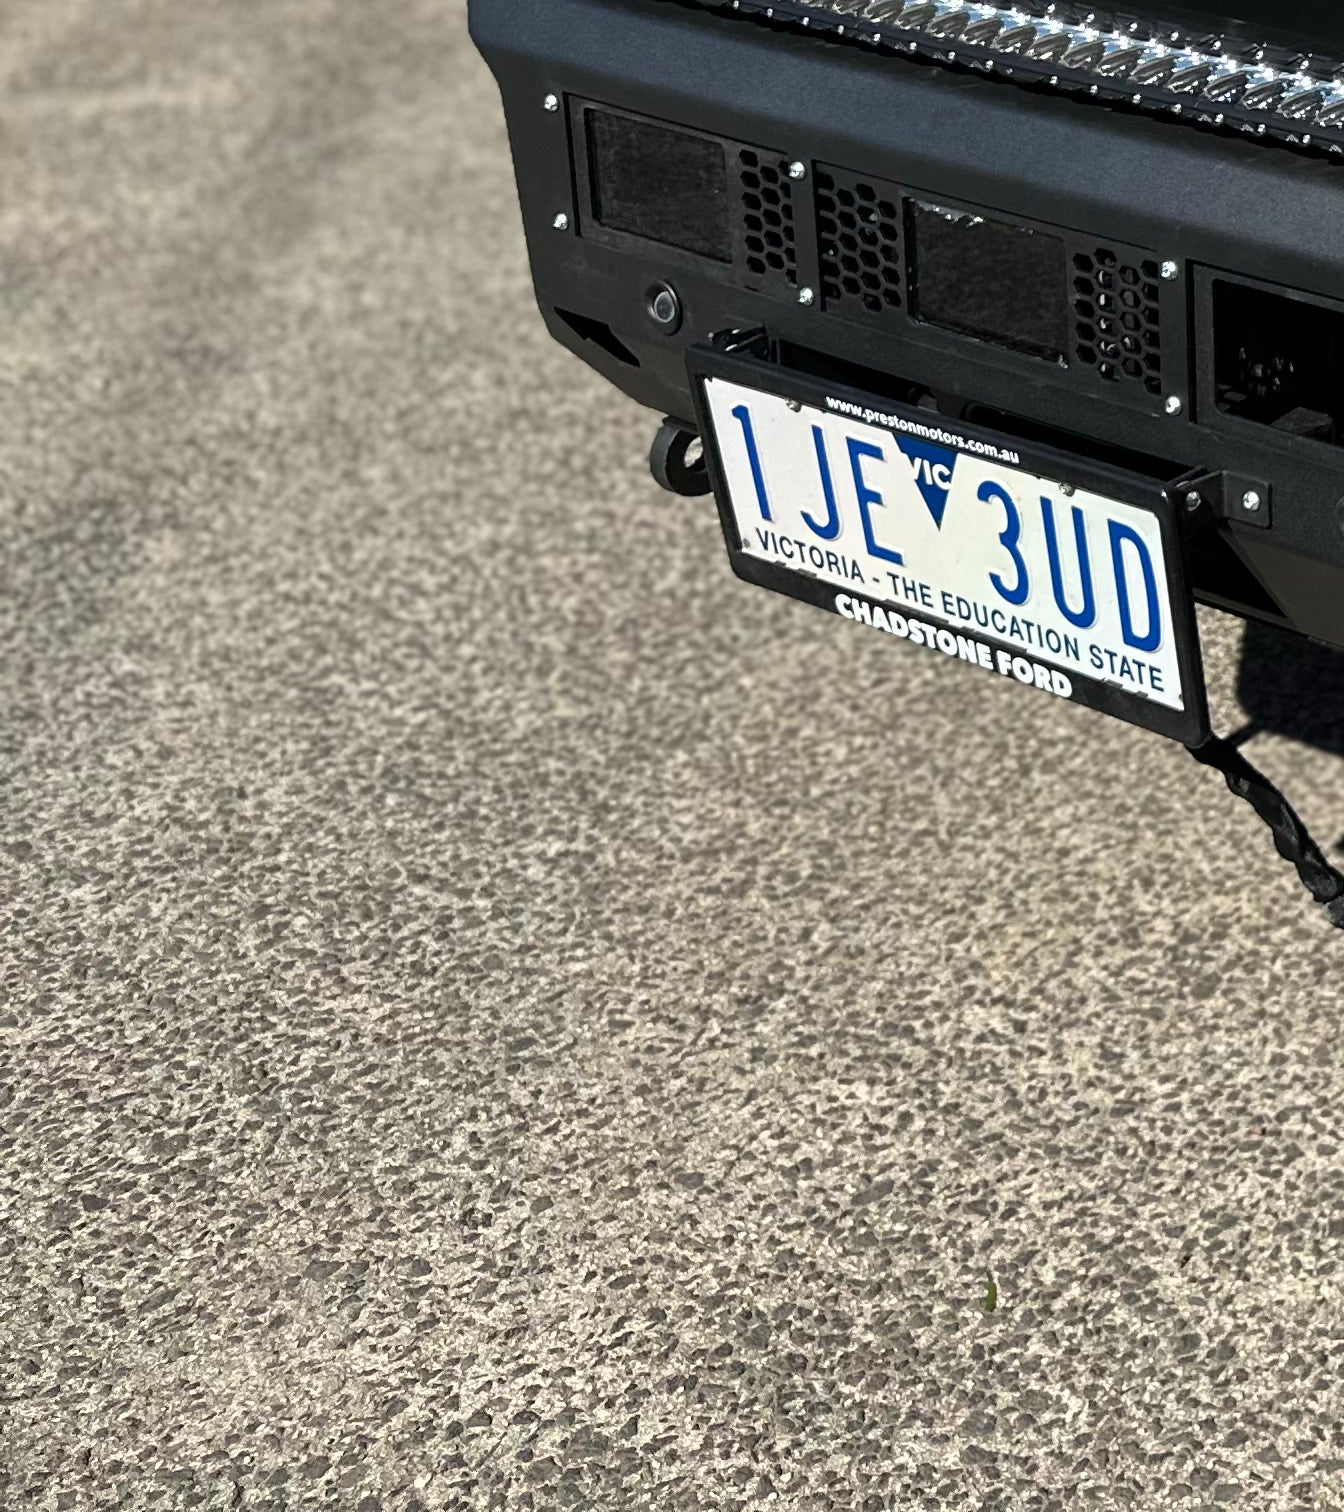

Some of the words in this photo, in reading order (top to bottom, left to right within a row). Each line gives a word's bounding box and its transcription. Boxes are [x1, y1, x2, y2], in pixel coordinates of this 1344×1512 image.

[826, 395, 1020, 465] www.prestonmotors.com.au
[911, 456, 952, 490] VIC
[755, 527, 866, 585] VICTORIA
[886, 571, 935, 608] THE
[940, 590, 1081, 662] EDUCATION
[1089, 643, 1165, 692] STATE
[834, 593, 994, 670] CHADSTONE
[996, 649, 1073, 698] FORD
